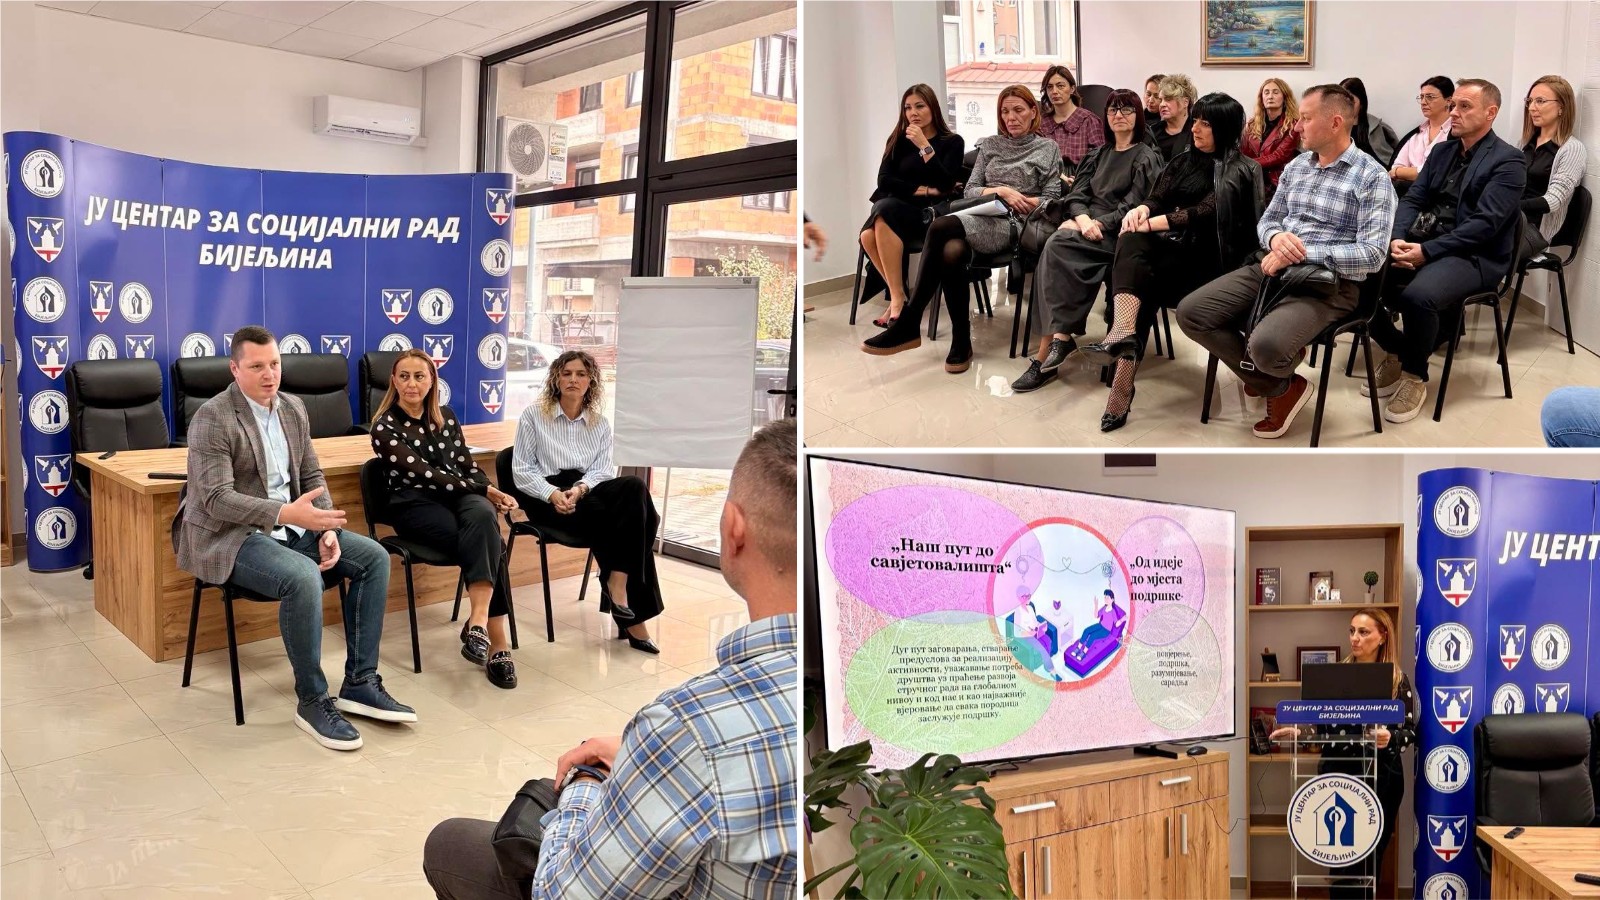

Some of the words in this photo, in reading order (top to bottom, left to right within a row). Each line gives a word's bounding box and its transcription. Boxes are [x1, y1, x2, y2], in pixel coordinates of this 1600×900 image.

[84, 196, 108, 226] ЈУ
[112, 200, 201, 231] ЦЕНТАР
[207, 210, 240, 233] ЗА
[246, 212, 401, 242] СОЦИЈАЛНИ
[407, 216, 460, 244] РАД
[199, 244, 332, 272] БИЈЕЉИНА
[945, 544, 972, 558] пут
[976, 546, 994, 558] до
[1499, 530, 1528, 564] ЈУ
[1154, 556, 1183, 570] идеје
[1130, 576, 1144, 586] до
[1147, 572, 1182, 587] мјеста
[892, 646, 908, 654] Дуг
[911, 646, 926, 655] пут
[928, 646, 979, 654] заговарања,
[900, 656, 949, 664] предуслова
[896, 676, 936, 684] друштва
[950, 673, 985, 682] праћење
[987, 672, 1016, 682] развоја
[897, 686, 937, 695] стручног
[940, 685, 959, 693] рада
[973, 682, 1017, 690] глобалном
[886, 697, 914, 706] нивоу
[982, 690, 1026, 700] најважније
[896, 705, 941, 715] вјеровање
[981, 701, 1019, 710] породица
[918, 713, 960, 722] заслужује
[1296, 787, 1316, 813] ЦЕНТАР
[1317, 782, 1327, 790] ЗА
[1329, 780, 1372, 808] СОЦИЈАЛНИ
[1368, 808, 1376, 825] РАД
[1311, 848, 1357, 861] БИЈЕЉИНА
